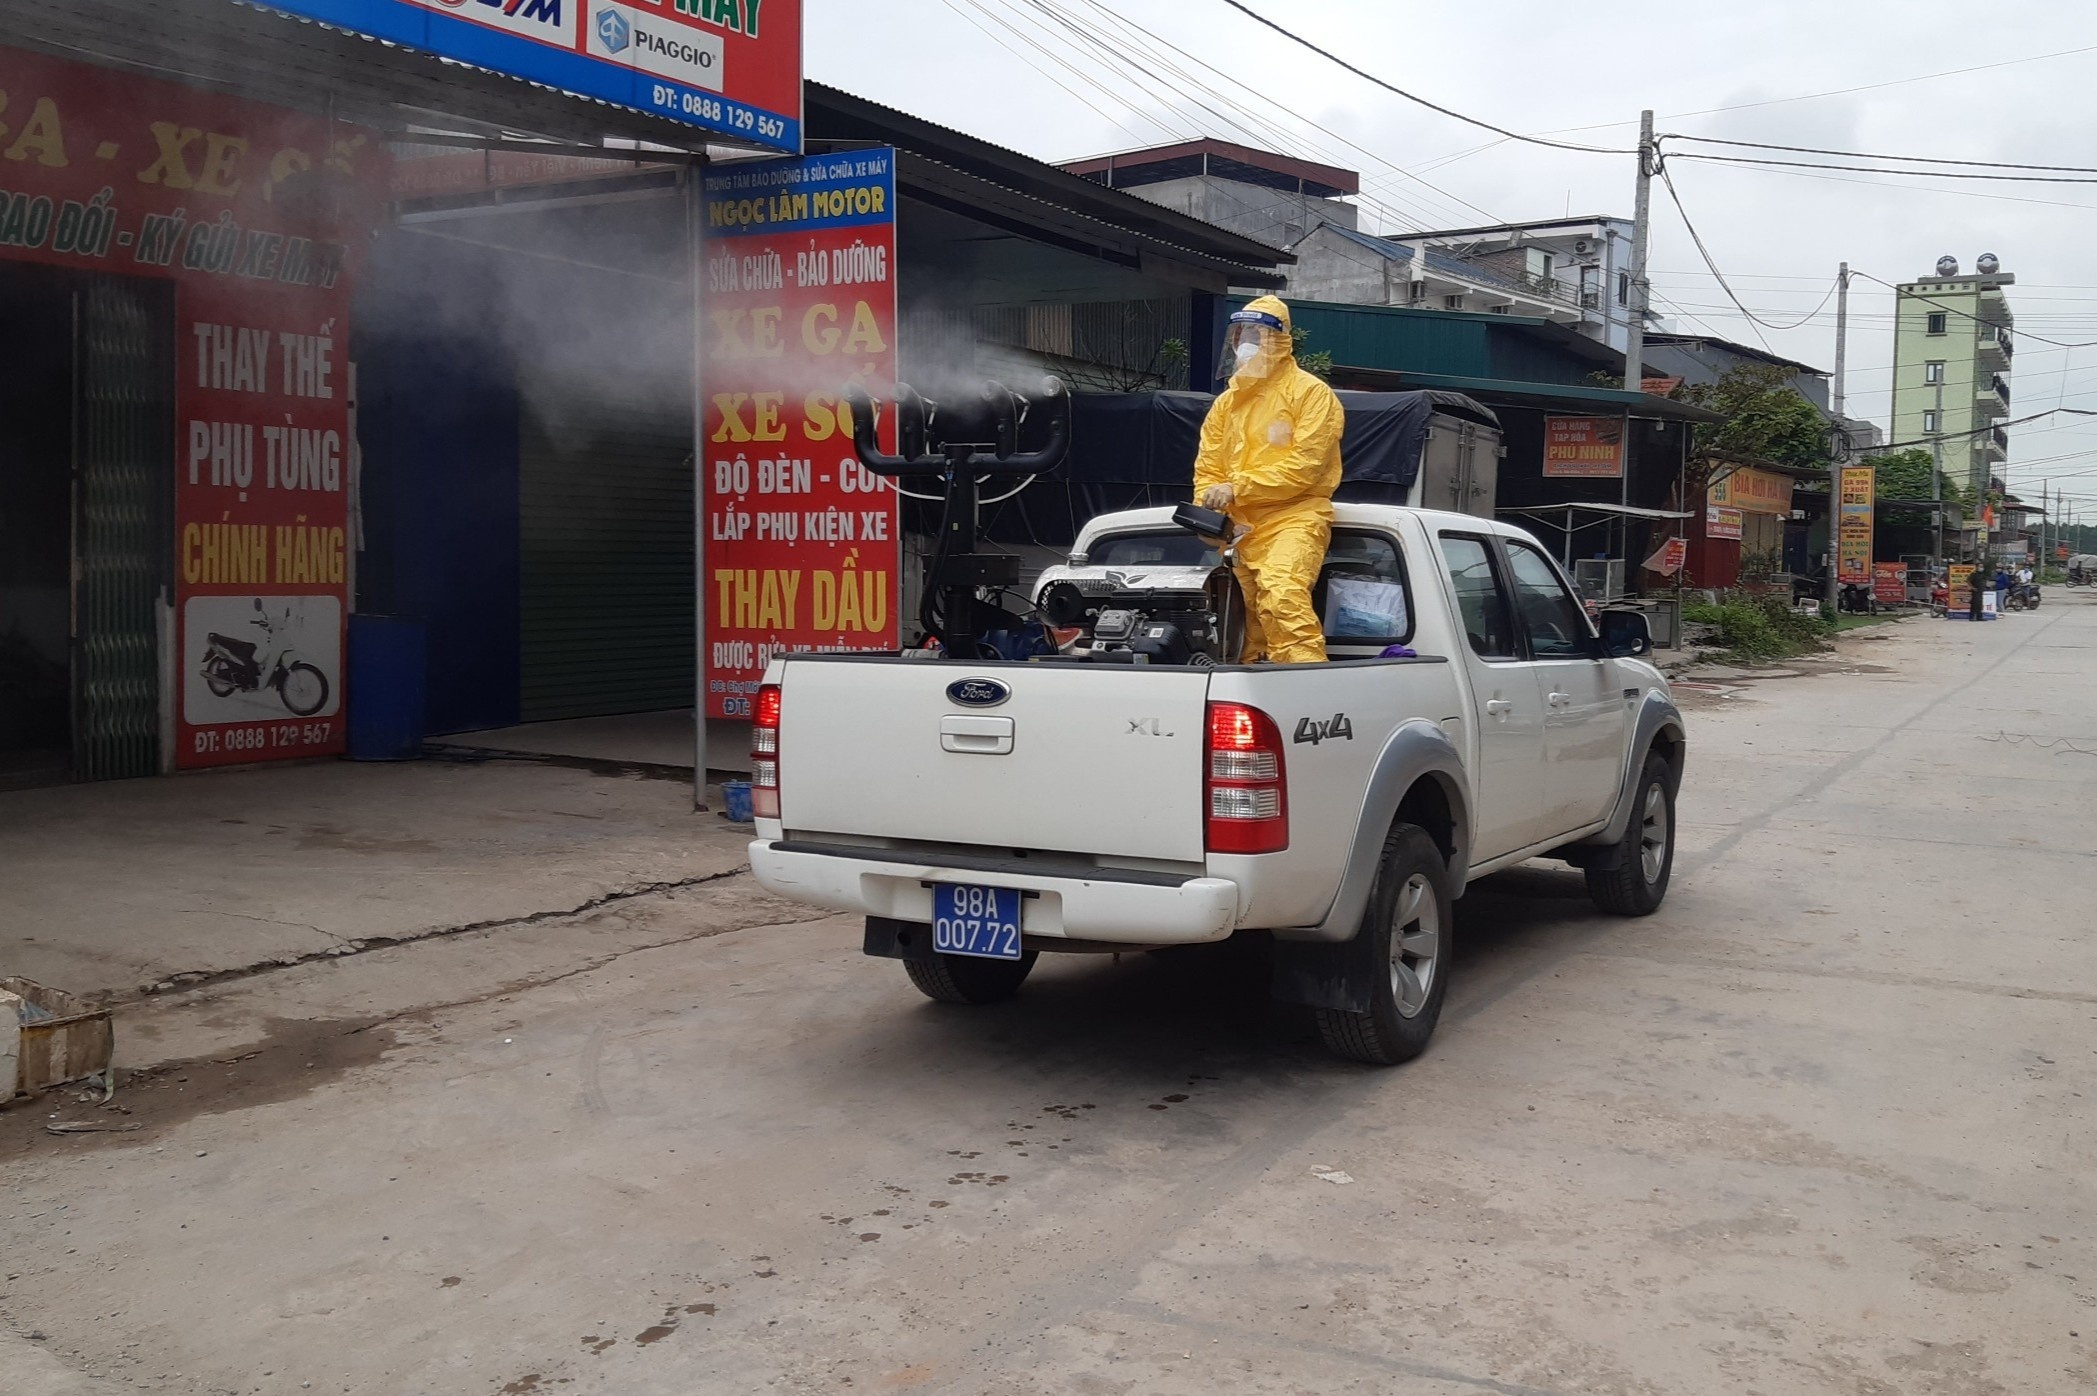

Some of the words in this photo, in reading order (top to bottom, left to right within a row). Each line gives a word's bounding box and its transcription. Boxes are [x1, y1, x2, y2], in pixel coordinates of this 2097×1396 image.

[634, 30, 712, 68] PIAGGIO
[653, 84, 678, 110] ĐT:
[682, 93, 721, 122] 0888
[727, 106, 754, 130] 129
[758, 115, 784, 139] 567
[0, 89, 69, 168] A
[136, 121, 248, 198] XE
[705, 175, 731, 192] TRUNG
[803, 168, 810, 182] &
[810, 161, 828, 182] SỬA
[829, 160, 854, 180] CHỮA
[855, 161, 867, 177] XE
[868, 155, 888, 175] MÁY
[709, 196, 765, 232] NGỌC
[769, 188, 808, 223] LÂM
[813, 186, 885, 218] MOTOR
[135, 207, 186, 266] KÝ
[237, 229, 282, 279] XE
[709, 245, 739, 294] SỬA
[743, 247, 783, 292] CHỮA
[797, 238, 828, 288] BẢO
[833, 238, 886, 285] DƯỠNG
[709, 306, 784, 359] XE
[801, 300, 887, 356] GA
[193, 321, 270, 394] THAY
[280, 317, 335, 399] THẾ
[711, 390, 787, 443] XE
[189, 420, 253, 502] PHỤ
[263, 413, 340, 492] TÙNG
[1580, 446, 1614, 459] NINH
[714, 453, 750, 501] ĐỘ
[757, 452, 811, 494] ĐÈN
[712, 502, 751, 541] LẮP
[757, 512, 798, 547] PHỤ
[804, 505, 854, 547] KIỆN
[860, 511, 888, 541] XE
[183, 511, 267, 584] CHÍNH
[276, 514, 344, 584] HÃNG
[714, 569, 801, 630] THAY
[813, 548, 887, 633] DẦU
[713, 639, 753, 675] ĐƯỢC
[723, 697, 750, 715] ĐT:
[960, 683, 994, 699] Ford
[195, 731, 220, 753] ĐT:
[225, 728, 265, 750] 0888
[271, 726, 298, 747] 129
[303, 723, 331, 745] 567
[1124, 717, 1175, 737] XL
[1294, 713, 1353, 745] 4x4
[954, 886, 998, 919] 98A
[937, 918, 1017, 955] 007.72
